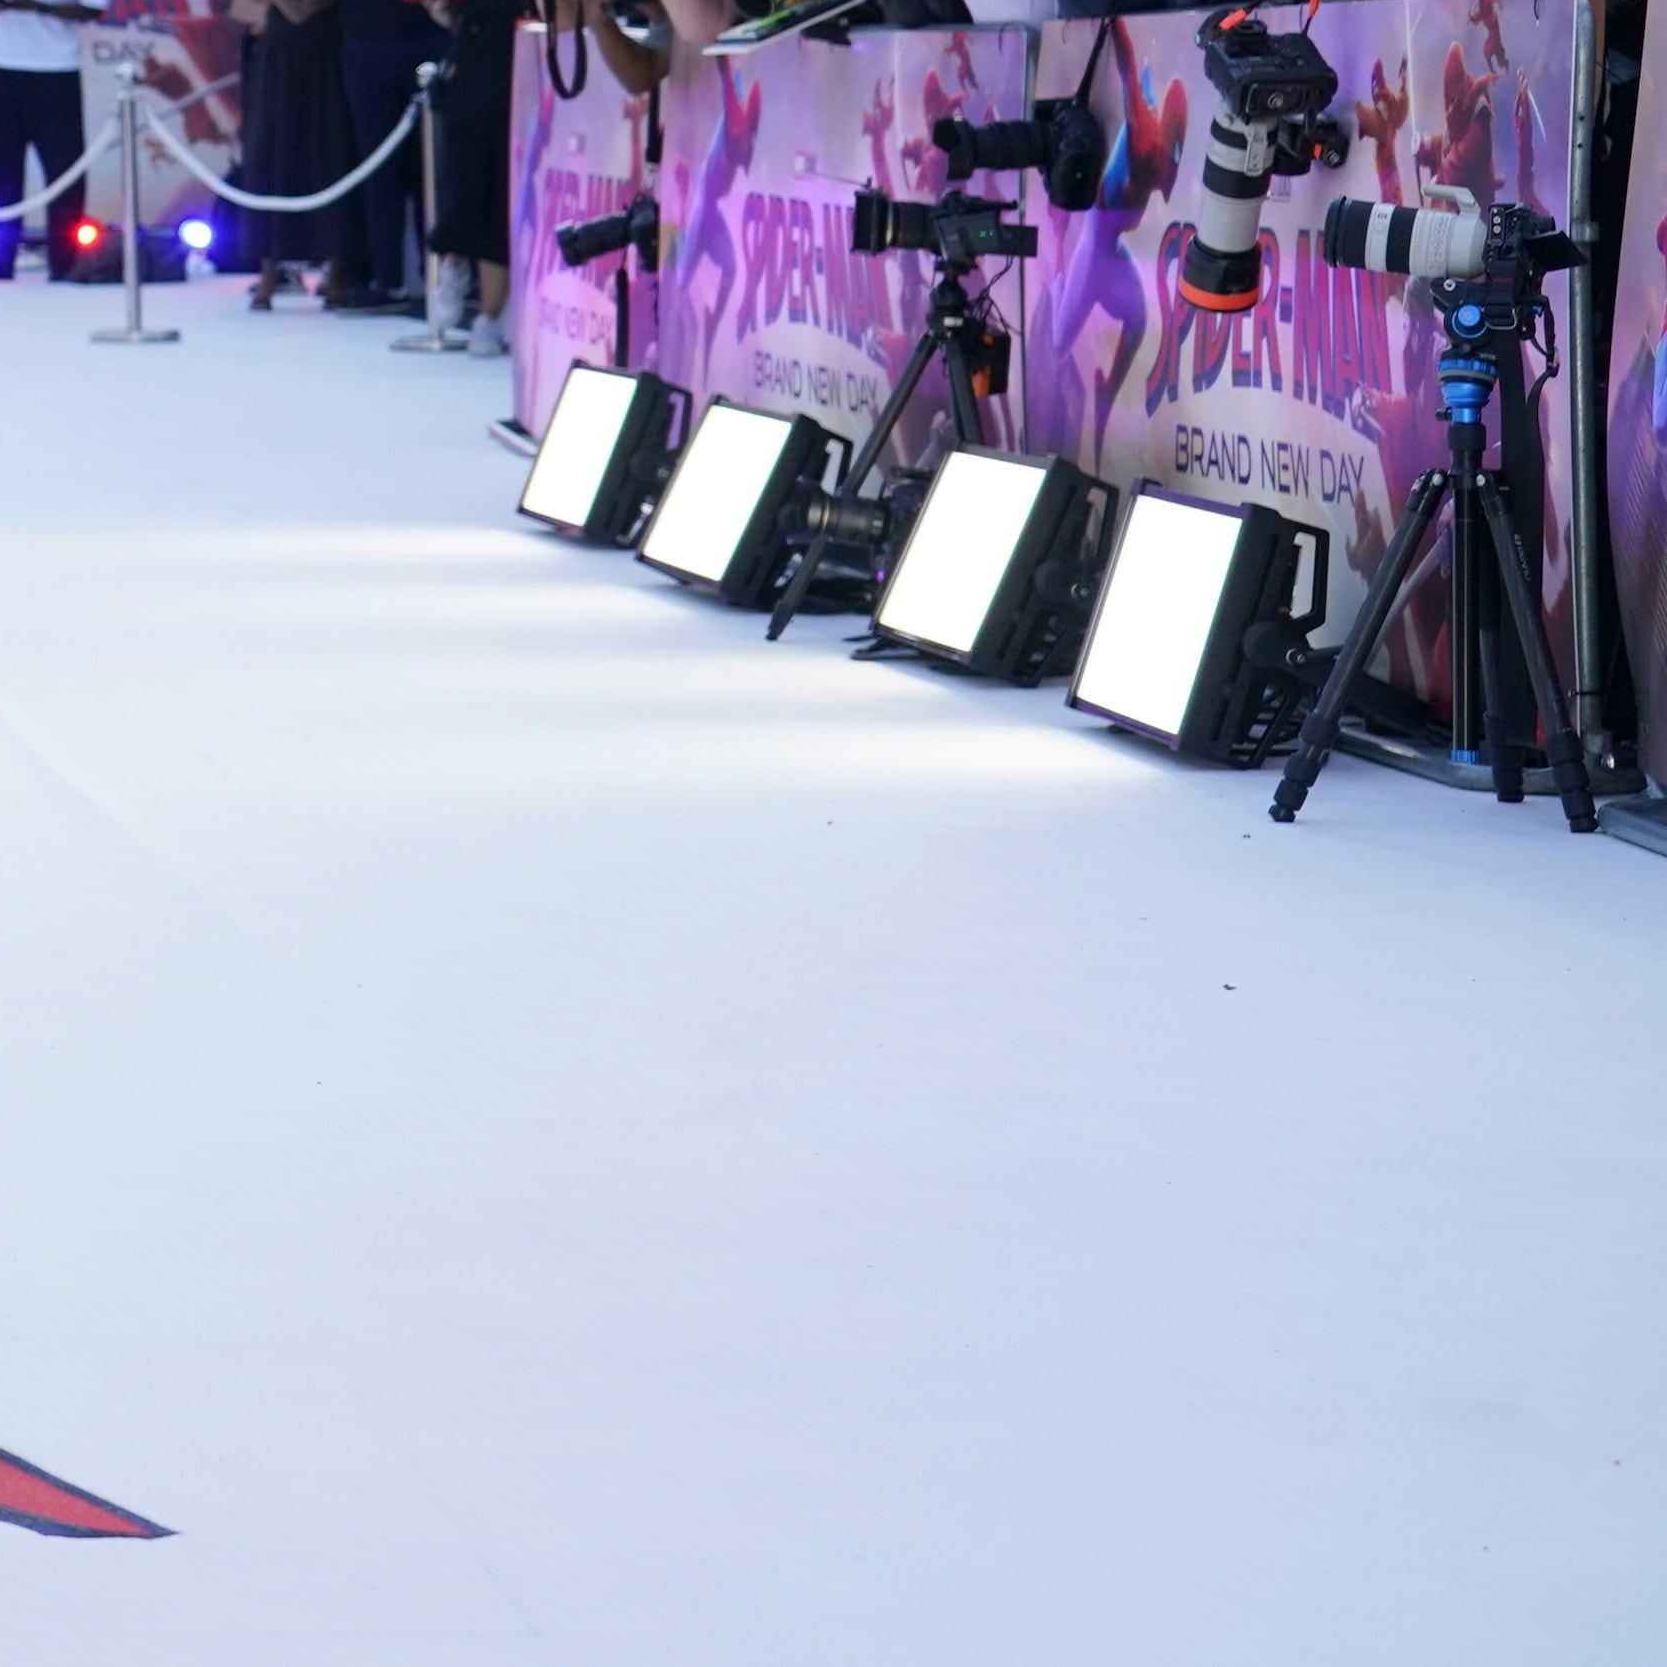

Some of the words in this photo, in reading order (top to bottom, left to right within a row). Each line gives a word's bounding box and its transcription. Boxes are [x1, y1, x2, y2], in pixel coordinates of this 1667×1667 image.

[92, 39, 155, 66] DAY
[754, 351, 803, 399] BRAND
[807, 363, 842, 408] NEW
[846, 372, 878, 415] DAY
[1175, 424, 1252, 485] BRAND
[1260, 438, 1310, 499] NEW
[1320, 448, 1365, 508] DAY
